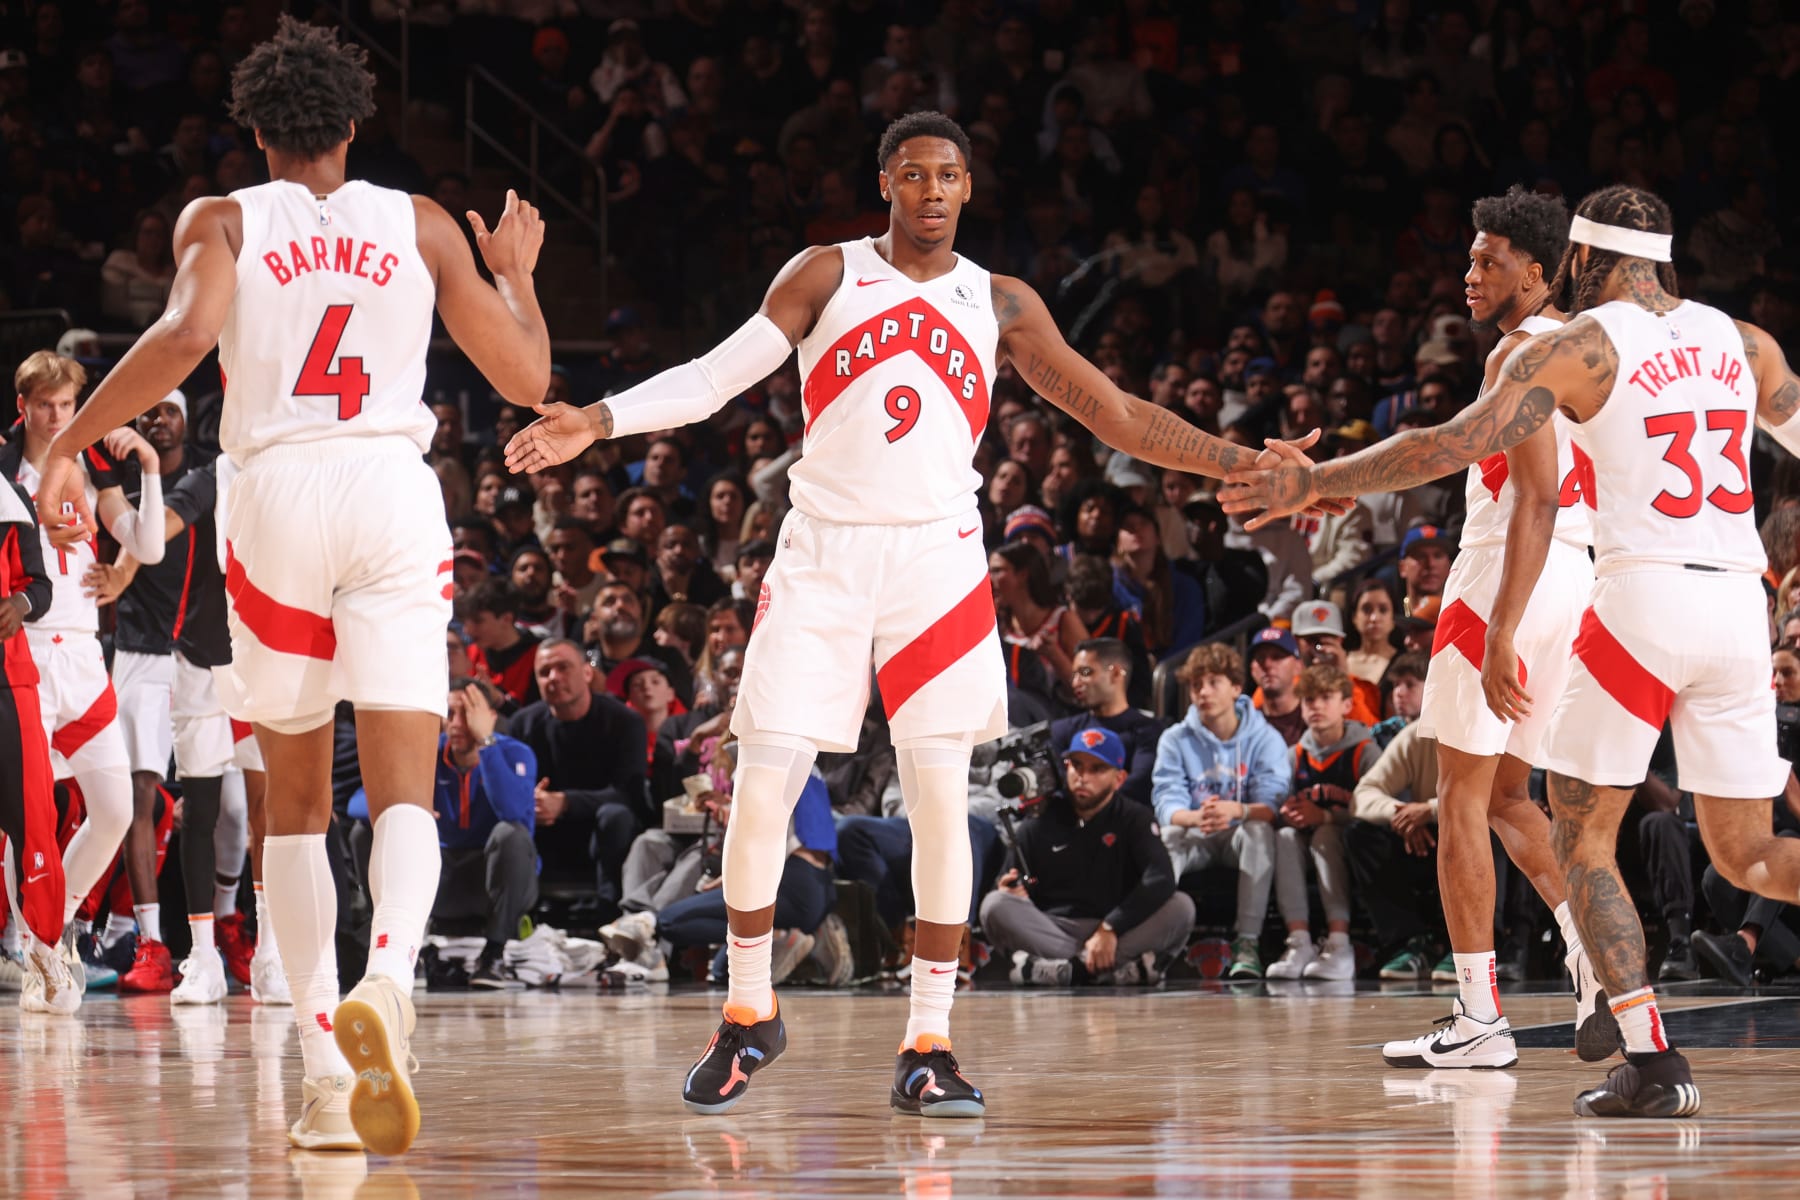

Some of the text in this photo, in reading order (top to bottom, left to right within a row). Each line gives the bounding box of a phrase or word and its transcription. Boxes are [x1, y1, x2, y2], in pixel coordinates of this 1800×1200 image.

[263, 236, 399, 287] BARNES
[291, 303, 371, 421] 4
[835, 312, 977, 400] RAPTORS
[1628, 346, 1745, 398] TRENT JR.
[884, 385, 922, 444] 9
[1643, 409, 1755, 519] 33
